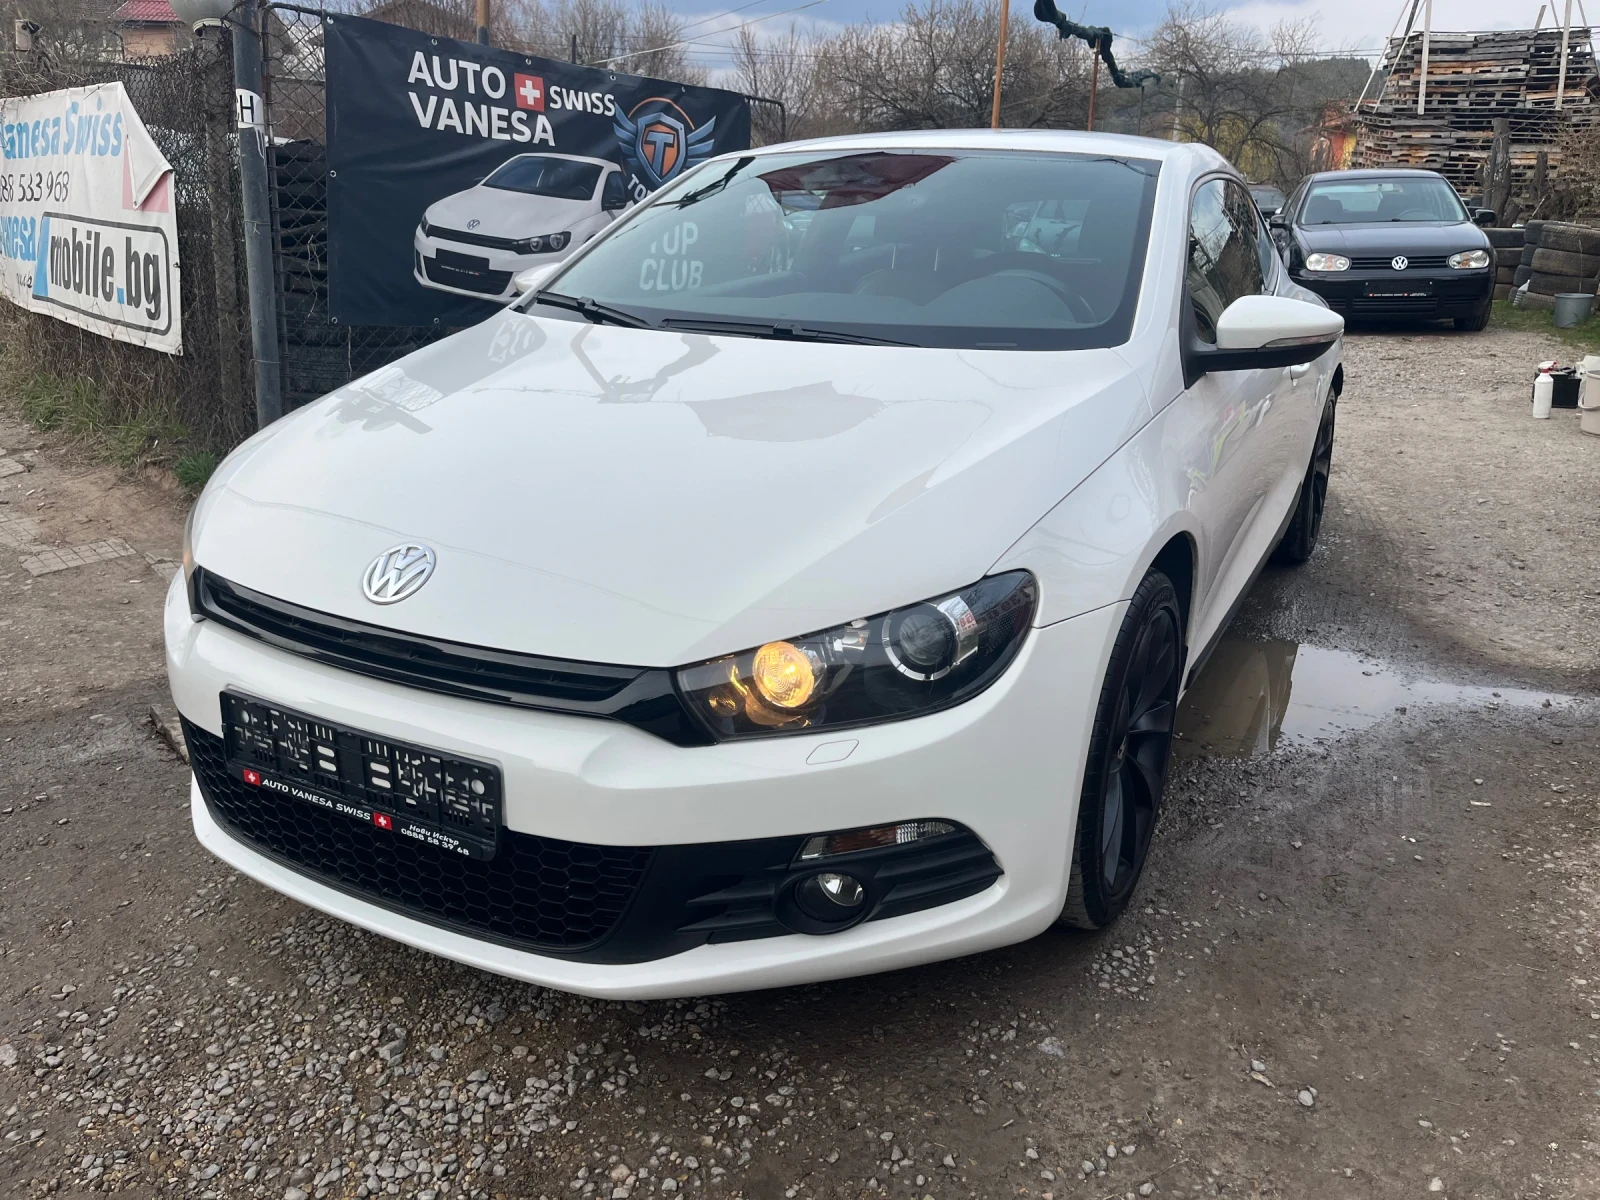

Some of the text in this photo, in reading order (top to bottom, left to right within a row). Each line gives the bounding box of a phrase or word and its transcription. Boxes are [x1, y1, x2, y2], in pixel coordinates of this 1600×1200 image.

[407, 50, 616, 117] AUTO SWISS
[0, 96, 122, 160] anesa Swiss
[408, 91, 556, 147] VANESA
[627, 173, 653, 203] TO
[50, 226, 162, 321] mobile.bg
[639, 258, 704, 291] CLUB
[262, 778, 371, 820] AUTO VANESA SWISS
